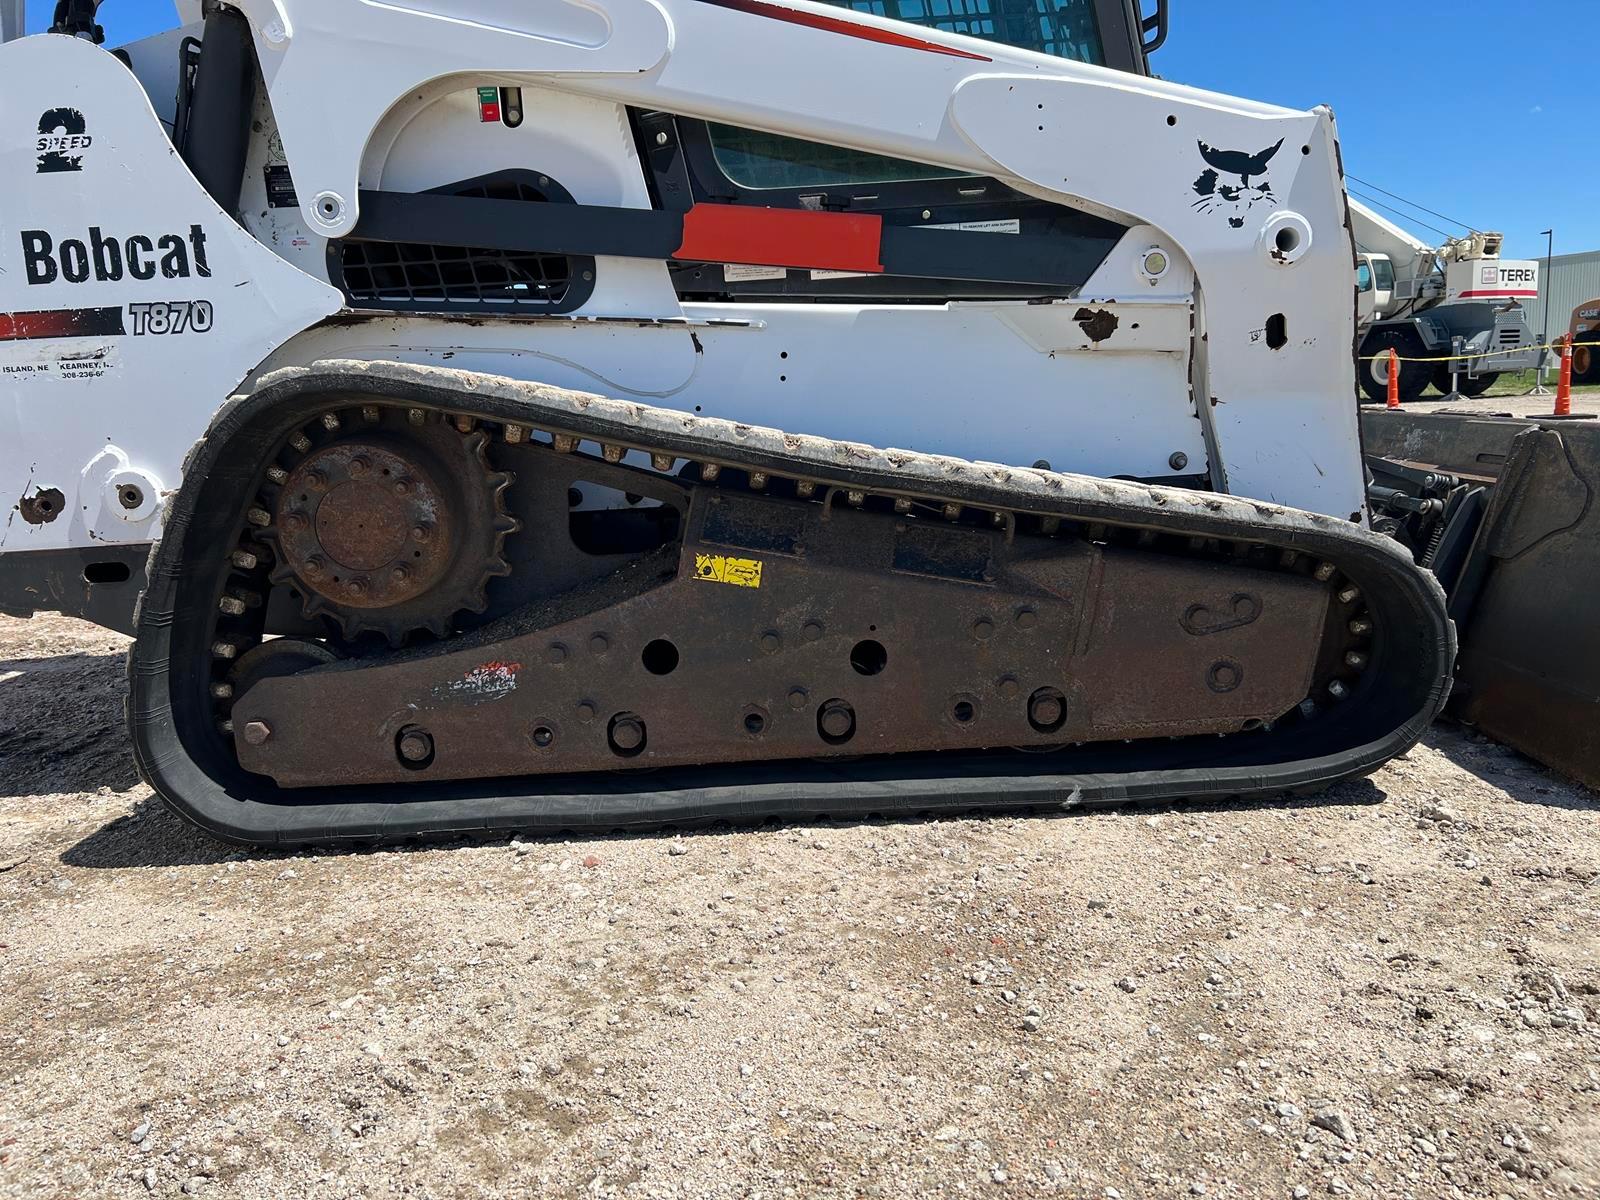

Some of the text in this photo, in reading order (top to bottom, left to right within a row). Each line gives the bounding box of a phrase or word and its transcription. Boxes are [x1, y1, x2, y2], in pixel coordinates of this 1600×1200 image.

[36, 135, 92, 151] SPEED
[21, 224, 212, 285] Bobcat
[1499, 269, 1535, 282] TEREX
[129, 300, 213, 336] T870
[1579, 309, 1598, 318] CASE
[2, 365, 36, 373] ISLAND,
[60, 361, 102, 370] KEARNEY,
